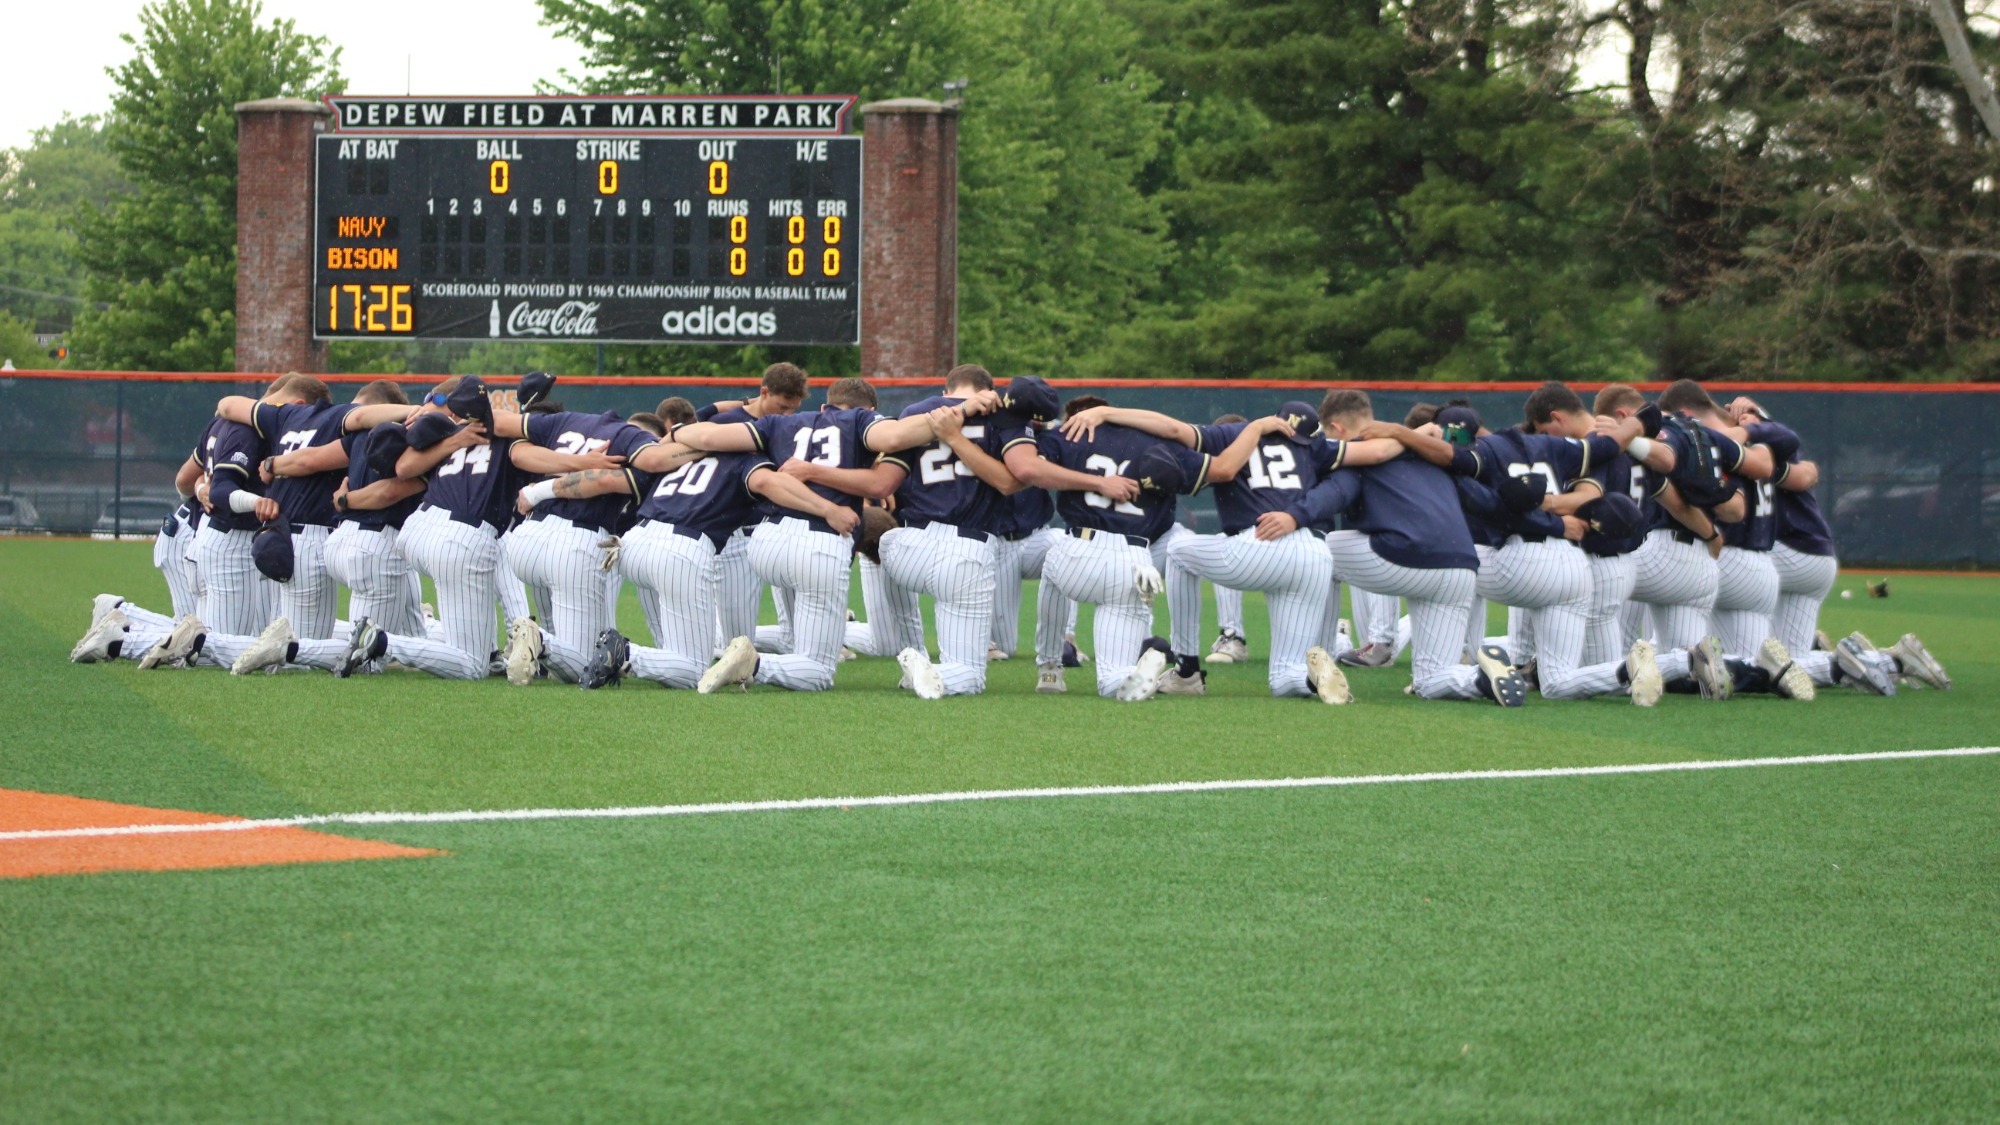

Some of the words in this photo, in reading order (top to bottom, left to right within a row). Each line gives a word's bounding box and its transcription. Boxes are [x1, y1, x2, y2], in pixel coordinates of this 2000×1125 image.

[346, 104, 446, 125] DEPEW
[464, 104, 545, 125] FIELD
[560, 104, 595, 125] AT
[612, 104, 738, 126] MARREN
[755, 105, 832, 126] PARK
[338, 140, 361, 159] AT
[366, 140, 399, 160] BAT
[476, 140, 522, 160] BALL
[576, 140, 641, 160] STRIKE
[699, 140, 737, 160] OUT
[796, 140, 828, 162] H/E
[490, 160, 509, 194] 0
[599, 160, 618, 194] 0
[708, 160, 728, 195] 0
[426, 199, 435, 215] 1
[449, 199, 458, 215] 2
[473, 199, 482, 215] 3
[508, 199, 518, 215] 4
[533, 199, 542, 215] 5
[557, 199, 566, 215] 6
[594, 199, 602, 216] 7
[617, 200, 626, 216] 8
[642, 200, 651, 216] 9
[673, 200, 691, 216] 10
[707, 200, 748, 216] RUNS
[769, 200, 803, 216] HITS
[817, 200, 847, 217] ERR
[338, 217, 387, 238] NAVY
[730, 215, 747, 244] 0
[788, 215, 805, 244] 0
[823, 215, 841, 244] 0
[327, 247, 398, 269] BISON
[730, 247, 747, 276] 0
[787, 247, 804, 276] 0
[823, 247, 840, 276] 0
[422, 283, 500, 297] SCOREBOARD
[504, 284, 564, 297] PROVIDED
[569, 284, 583, 297] BY
[588, 284, 614, 298] 1969
[617, 284, 711, 299] CHAMPIONSHIP
[713, 286, 750, 299] BISON
[754, 286, 810, 299] BASEBALL
[814, 287, 847, 300] TEAM
[330, 284, 412, 331] 17:26
[662, 305, 777, 336] adidas
[487, 389, 521, 414] 85
[793, 426, 841, 469] 13
[653, 457, 720, 497] 20
[1247, 444, 1302, 489] 12
